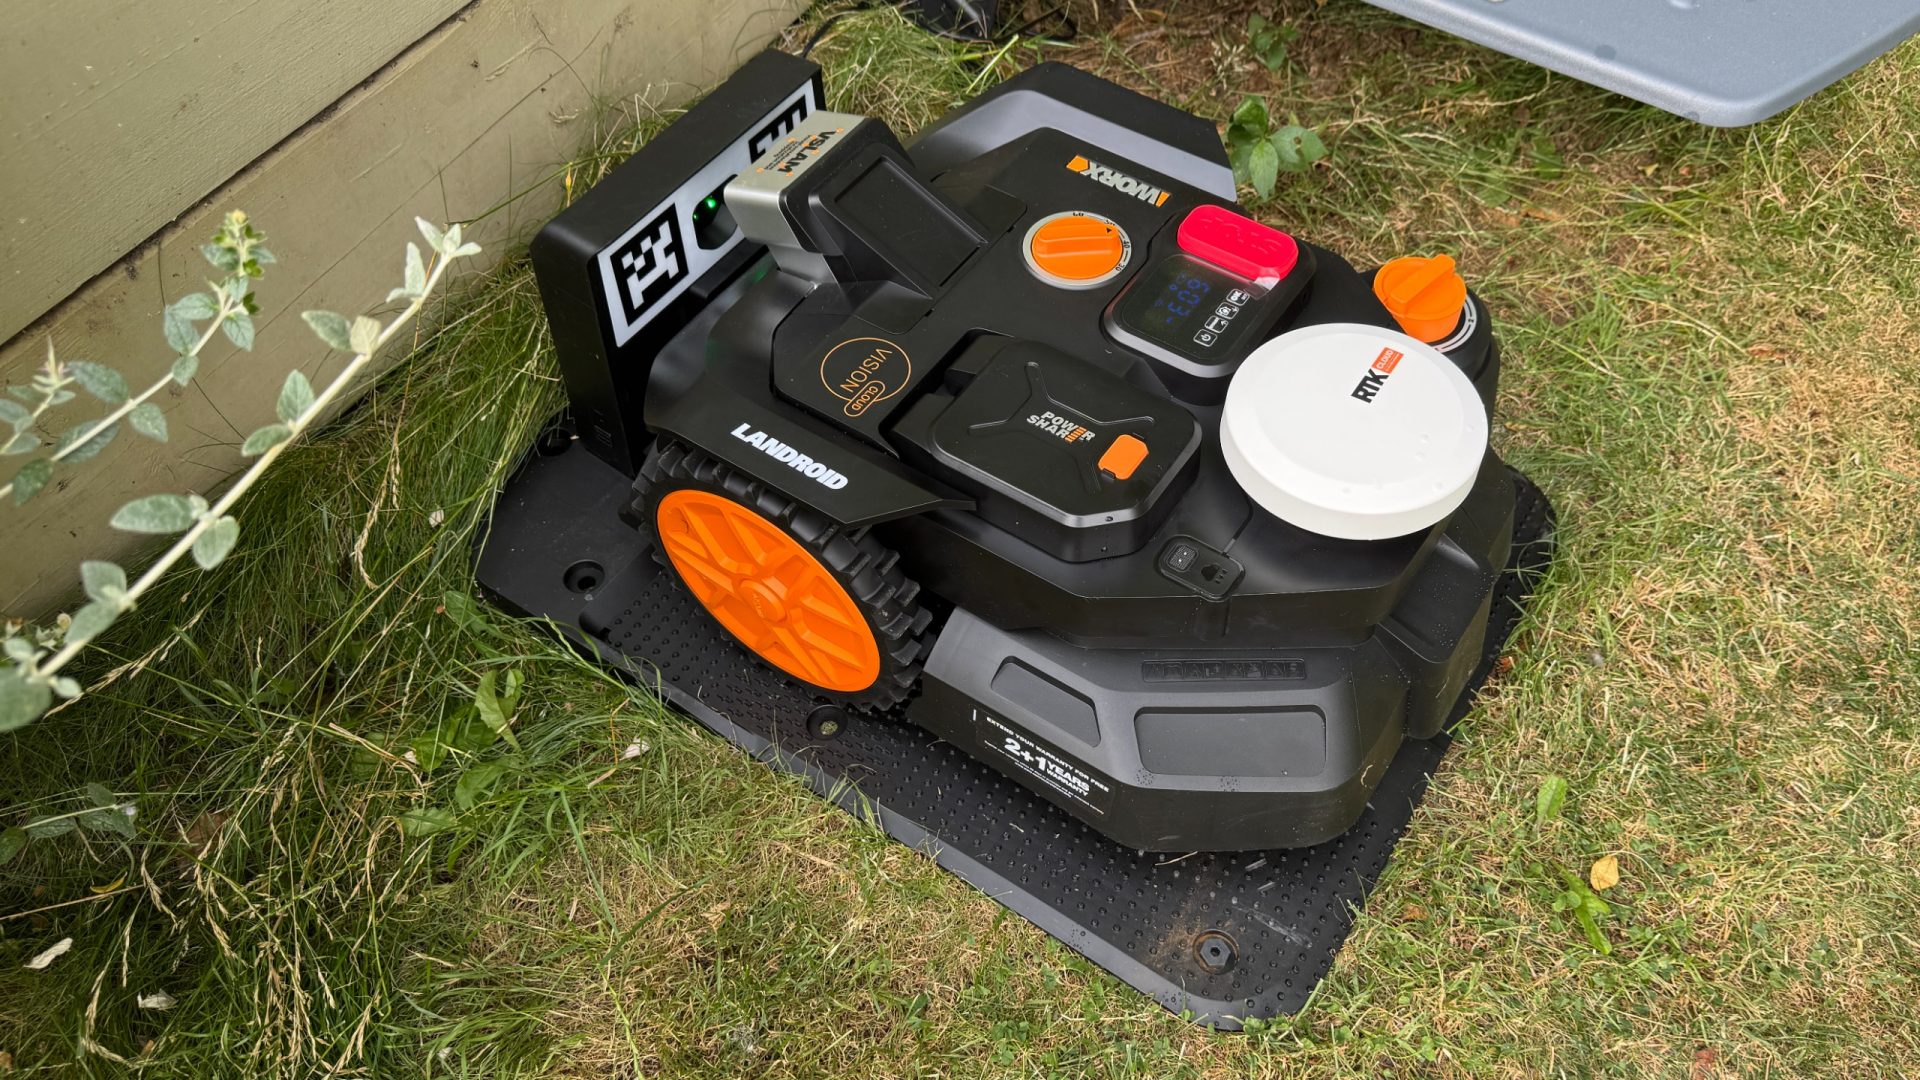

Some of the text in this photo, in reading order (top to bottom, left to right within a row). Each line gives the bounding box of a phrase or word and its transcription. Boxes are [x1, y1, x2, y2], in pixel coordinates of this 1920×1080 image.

[777, 131, 837, 173] VSLAM
[1080, 161, 1161, 205] WORX
[840, 348, 893, 393] VISION
[1350, 368, 1389, 404] RTK
[851, 386, 878, 411] CLOUD
[1026, 414, 1079, 443] SHARE
[1040, 411, 1096, 441] POWER
[730, 422, 849, 490] LANDROID
[986, 716, 1014, 736] EXTEND
[1015, 733, 1034, 748] YOUR
[1035, 745, 1074, 770] WARRANTY
[1074, 769, 1090, 780] FOR
[1090, 778, 1109, 792] FREE
[1004, 737, 1046, 771] 2+1
[1046, 760, 1090, 791] YEARS
[1046, 768, 1088, 796] WARRANTY
